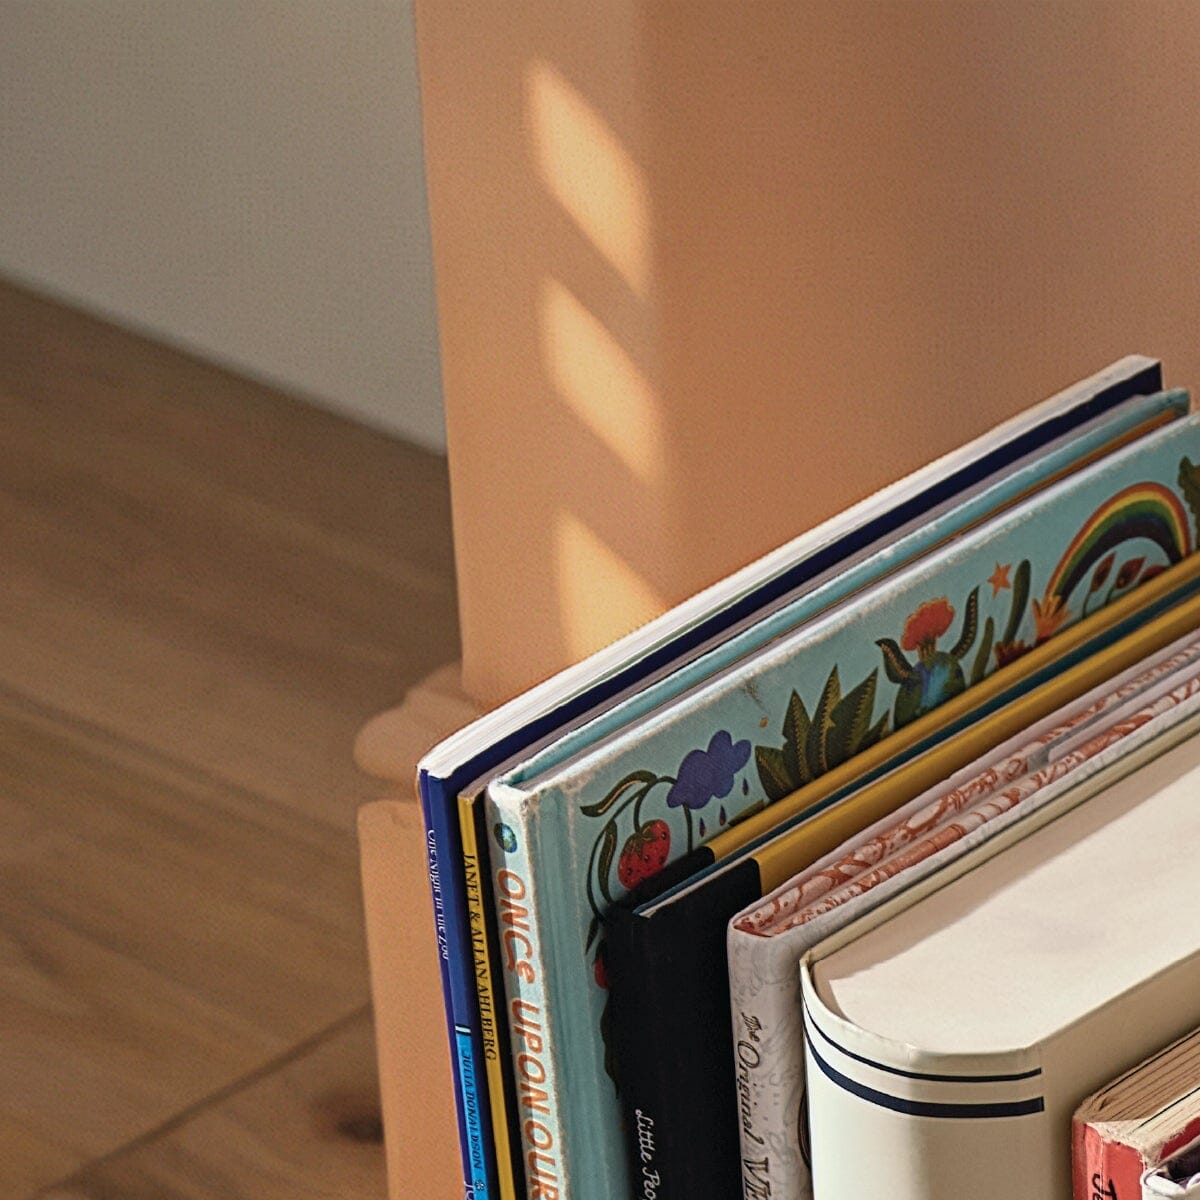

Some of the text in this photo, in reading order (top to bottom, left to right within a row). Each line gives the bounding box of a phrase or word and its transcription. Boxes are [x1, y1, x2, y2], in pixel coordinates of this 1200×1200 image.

[463, 855, 497, 1061] JANET & ALLAN AHLBERG
[461, 1049, 475, 1089] JULIA
[511, 998, 552, 1115] UPON
[737, 1041, 765, 1145] Original
[464, 1091, 483, 1170] DONALDSON
[634, 1108, 656, 1164] Little
